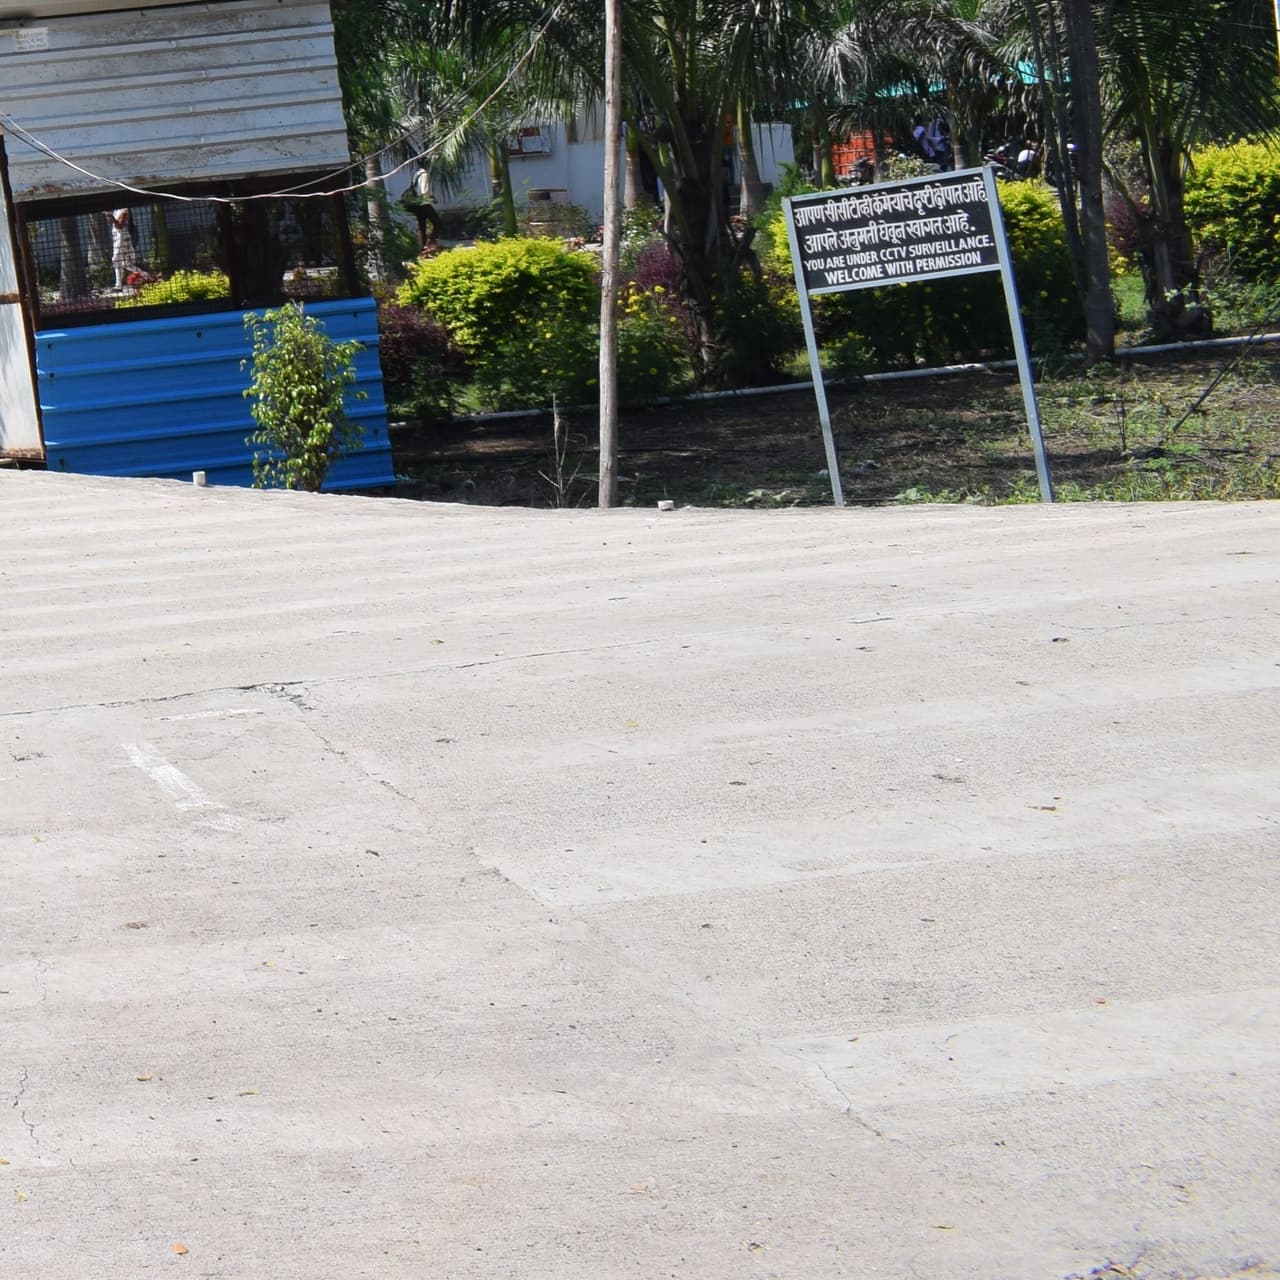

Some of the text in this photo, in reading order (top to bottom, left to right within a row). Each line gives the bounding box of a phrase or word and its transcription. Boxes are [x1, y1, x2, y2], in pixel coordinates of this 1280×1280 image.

[803, 234, 995, 271] YOU ARE UNDER CCTV SURVEILLANCE.
[824, 250, 982, 285] WELCOME WITH PERMISSION
